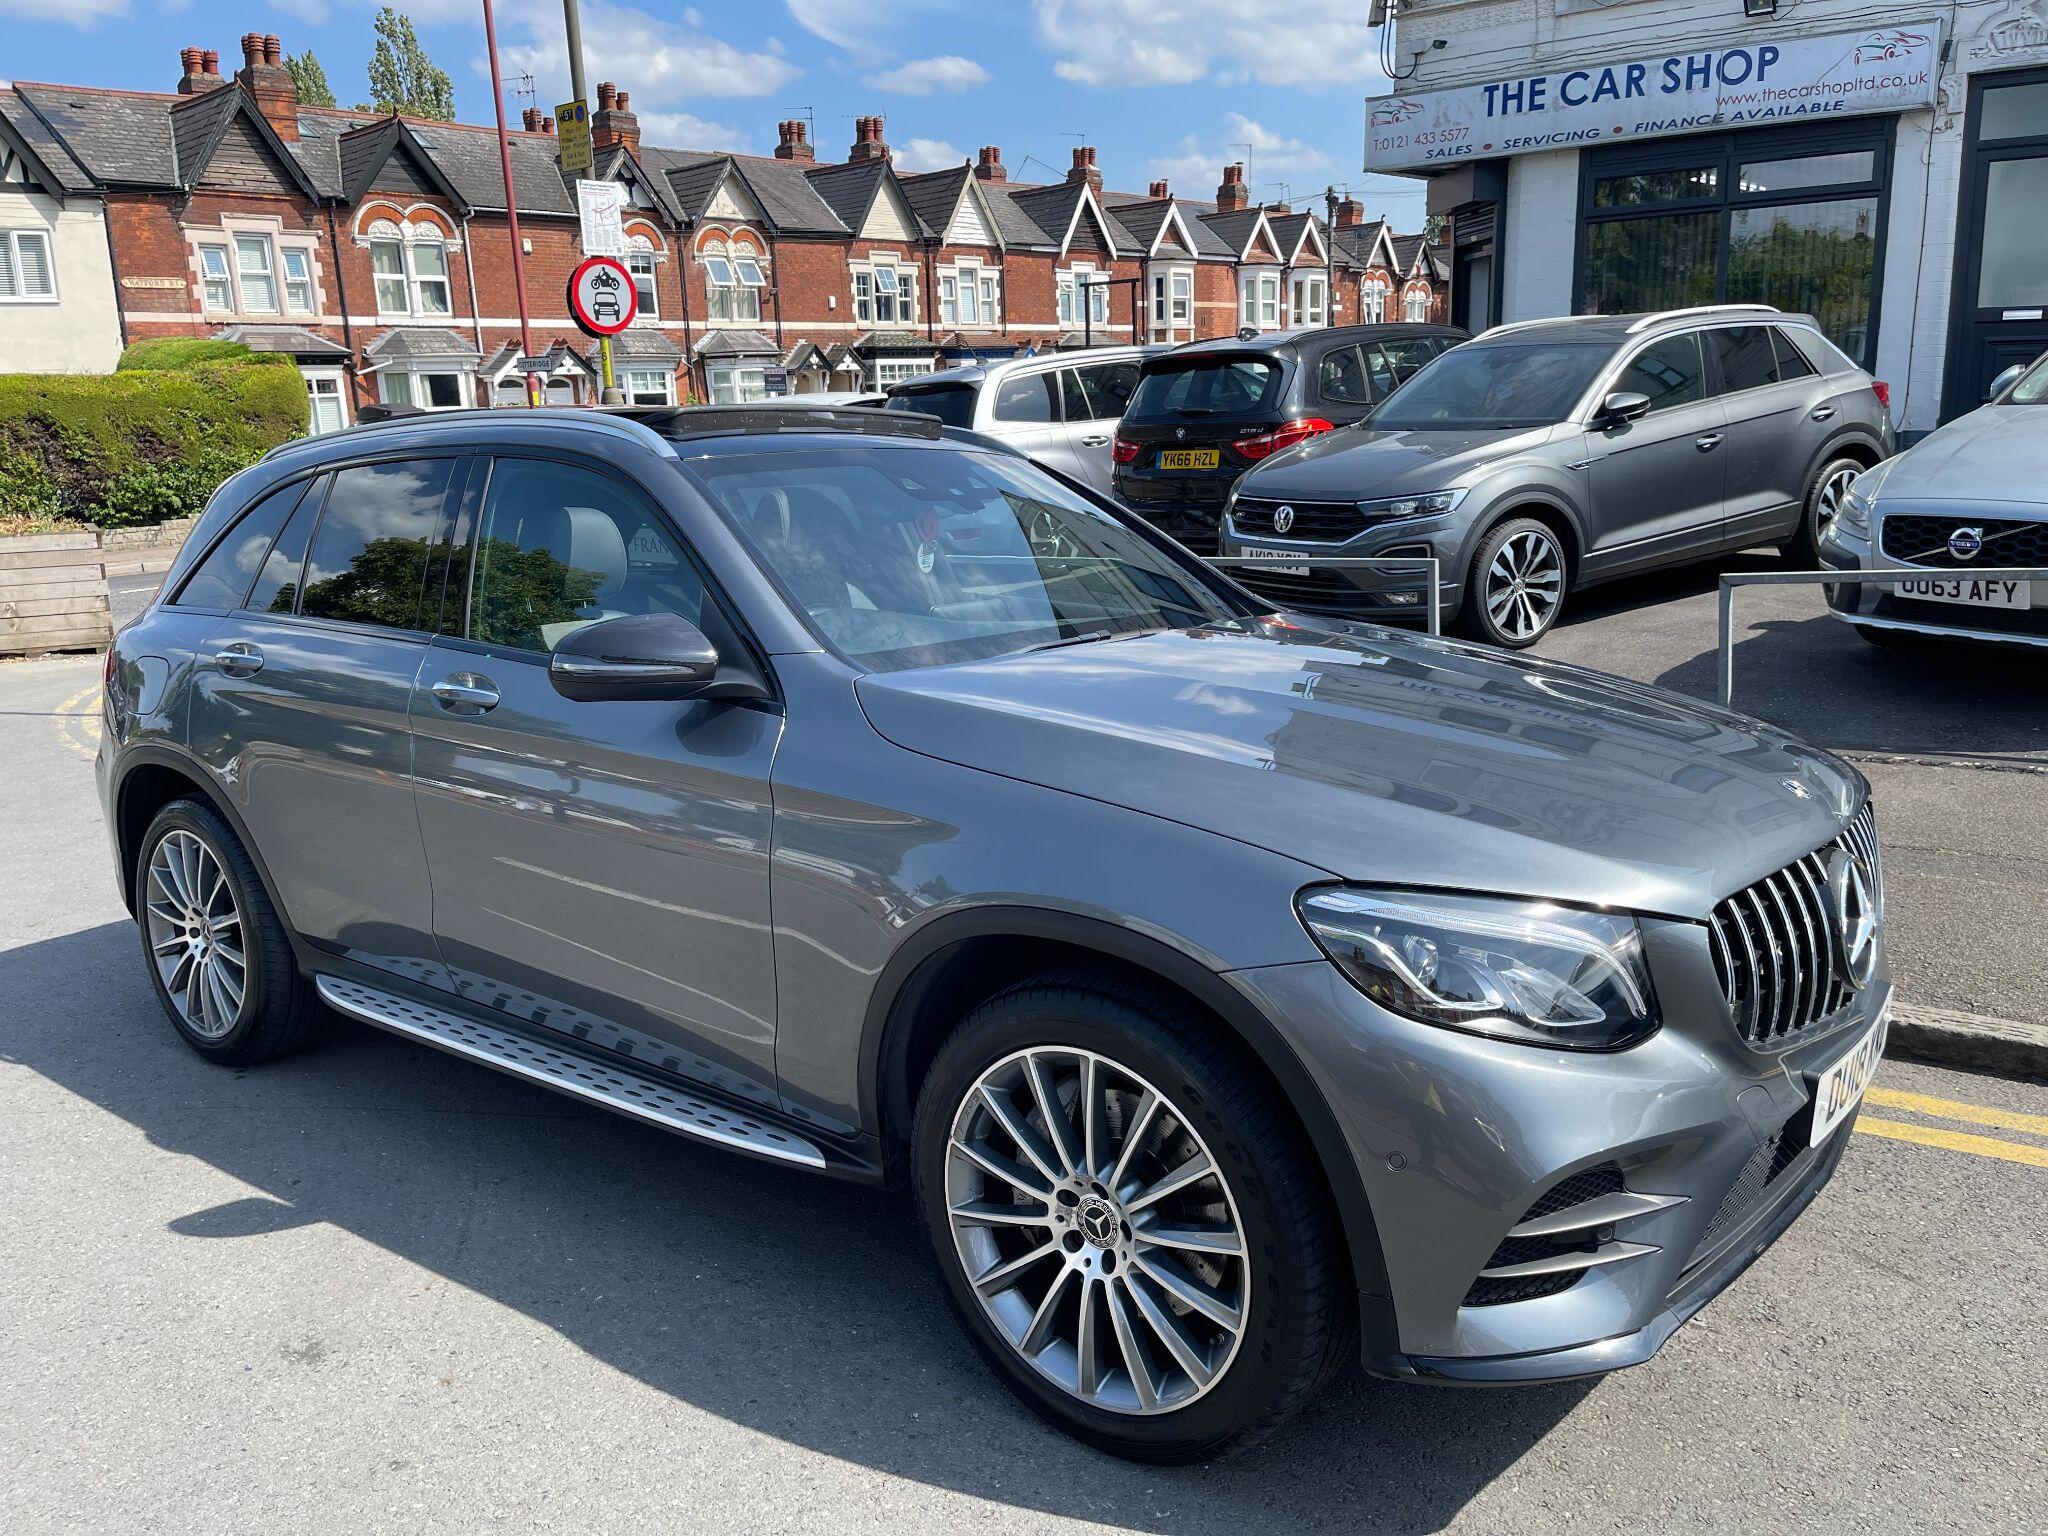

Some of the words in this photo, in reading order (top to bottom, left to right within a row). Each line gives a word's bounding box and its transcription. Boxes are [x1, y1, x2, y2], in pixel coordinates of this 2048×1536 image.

[1483, 77, 1547, 117] THE
[1560, 63, 1646, 107] CAR
[1660, 46, 1780, 94] SHOP
[1716, 70, 1928, 106] www.thecarshopltd.co.uk
[1373, 135, 1409, 151] T:0121
[1414, 129, 1435, 146] 433
[1439, 127, 1470, 143] 5577
[1425, 144, 1473, 159] SALES
[1502, 128, 1601, 149] SERVICING
[1633, 112, 1724, 134] FINANCE
[1730, 100, 1845, 122] AVAILABLE
[1163, 453, 1191, 467] YK66
[1194, 452, 1217, 467] HZL
[1969, 580, 2018, 603] AFY
